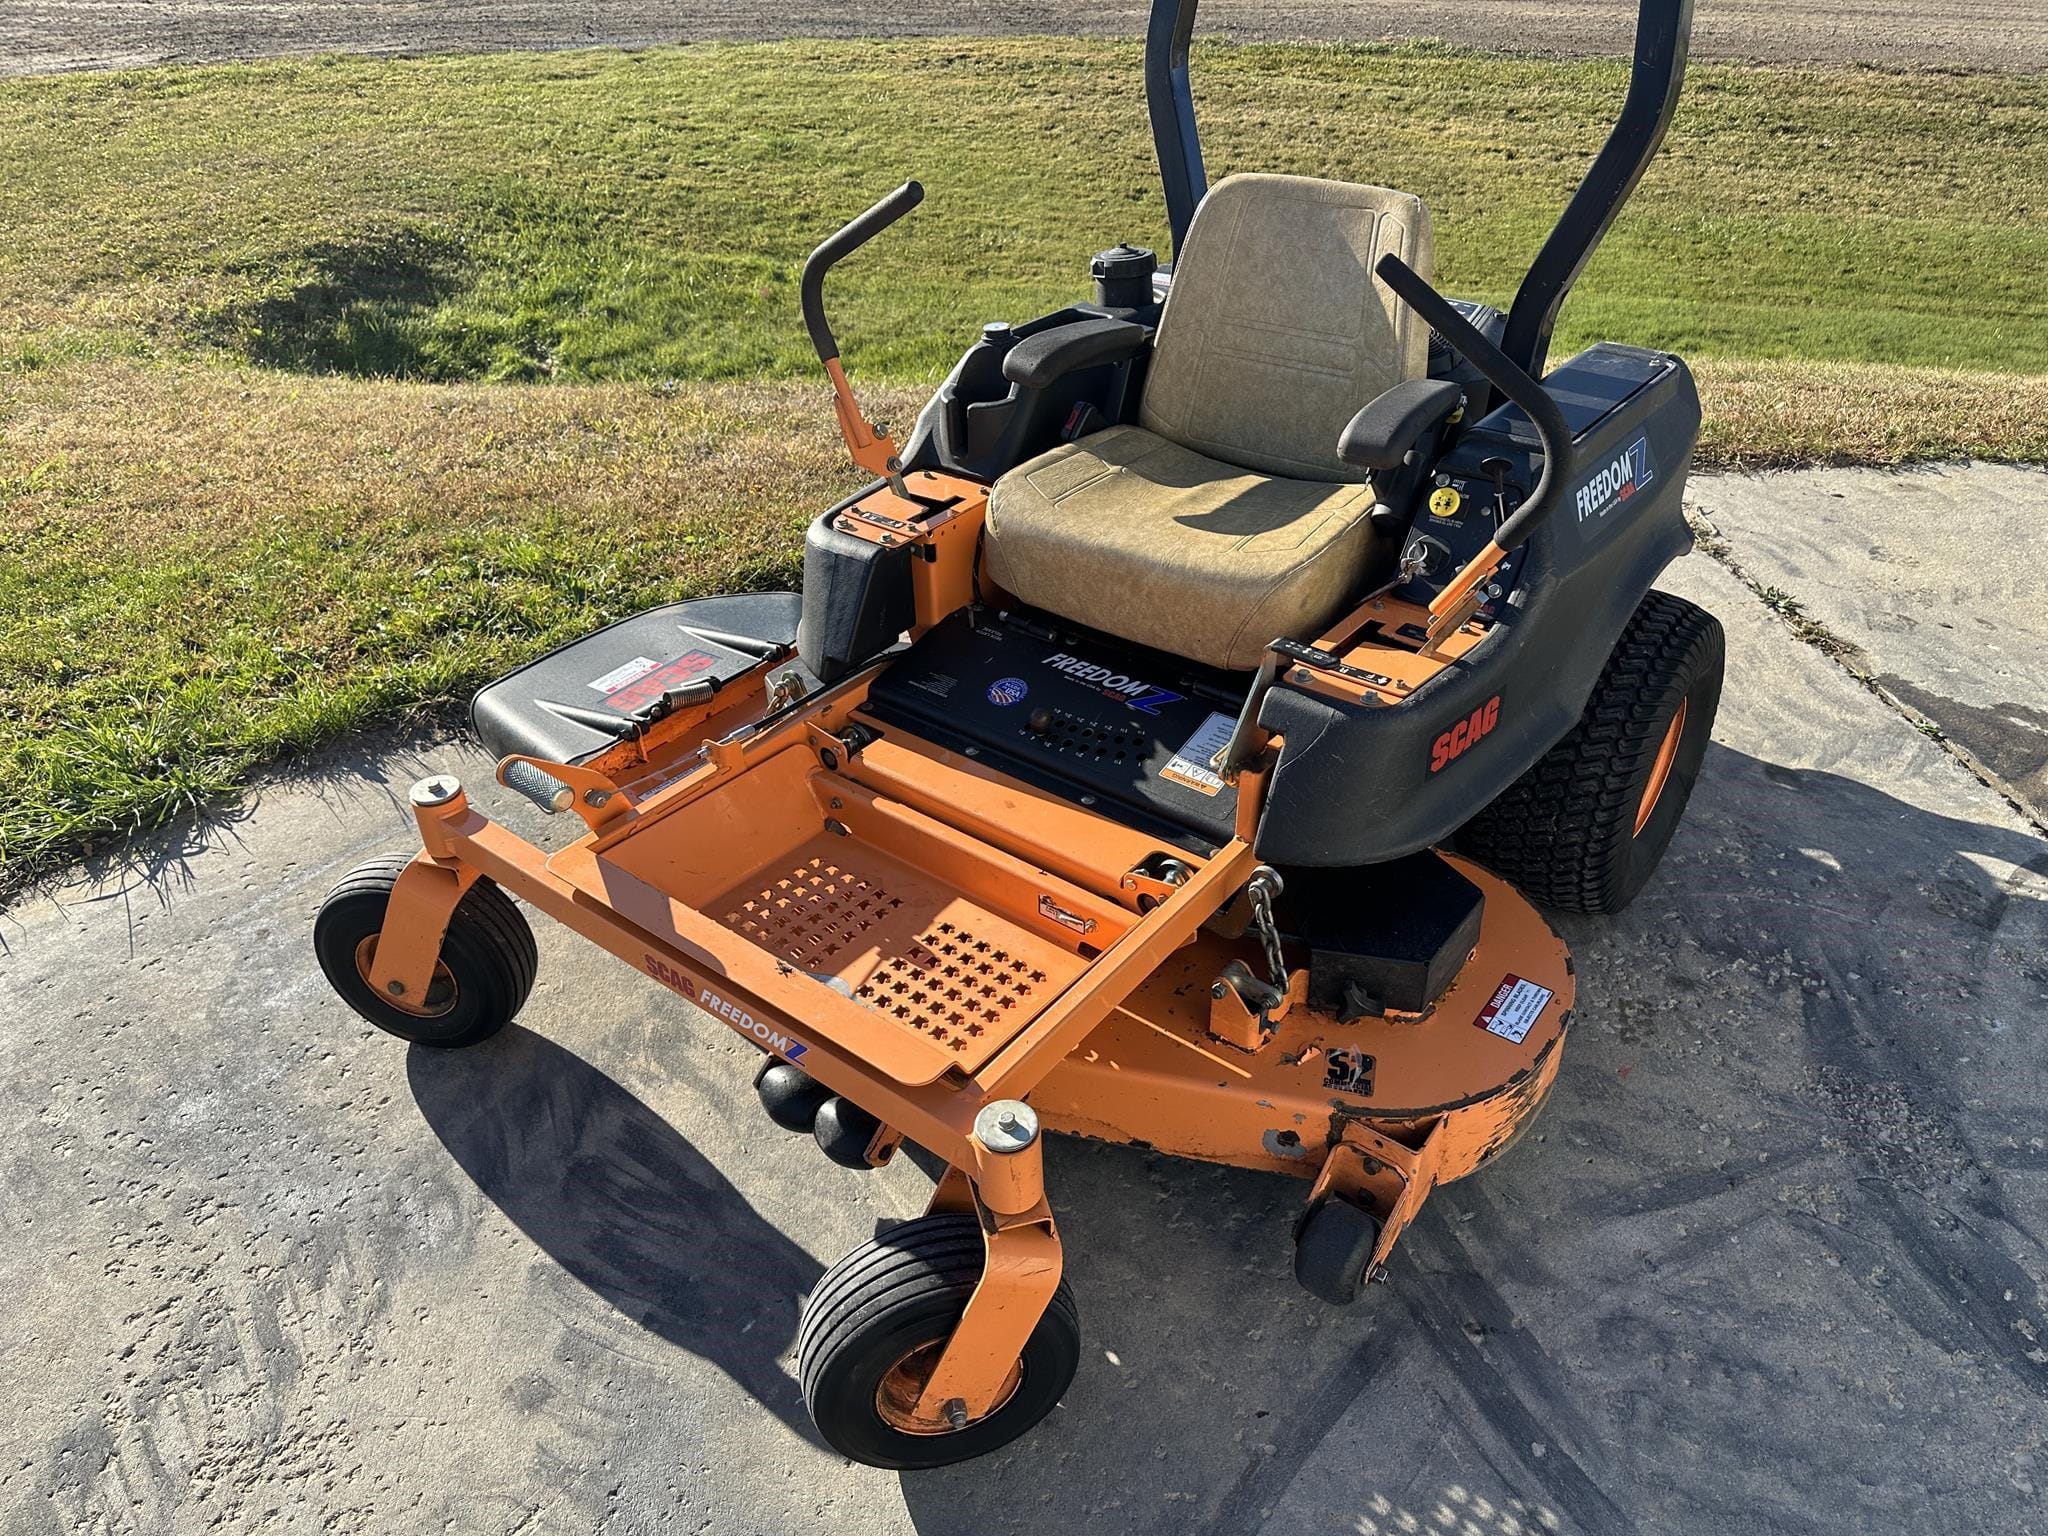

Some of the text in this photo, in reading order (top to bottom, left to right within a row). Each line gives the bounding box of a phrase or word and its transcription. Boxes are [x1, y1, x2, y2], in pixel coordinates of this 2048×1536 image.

[1576, 451, 1633, 522] FREEDOM
[1041, 653, 1151, 696] FREEDOM
[1430, 695, 1500, 773] SCAG
[644, 954, 696, 998] SCAG
[700, 989, 787, 1051] FREEDOM
[1490, 983, 1513, 1009] DANGER
